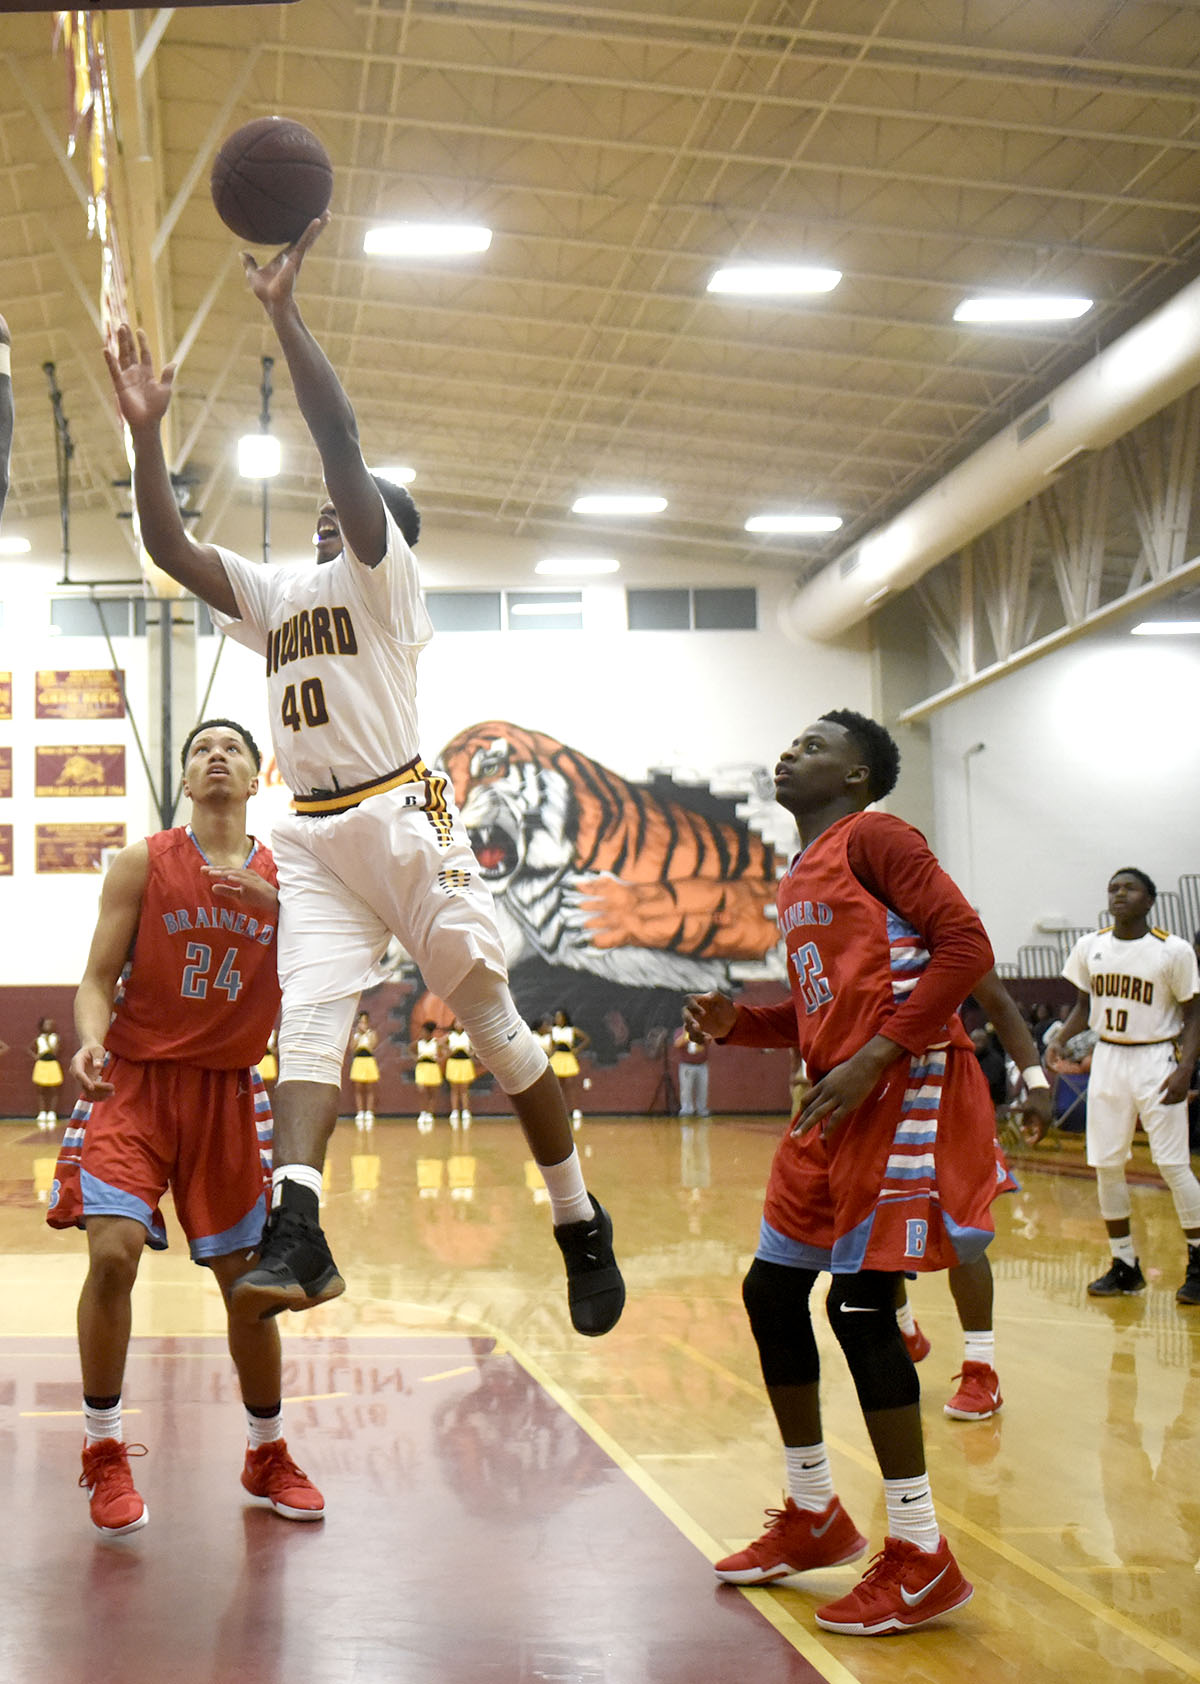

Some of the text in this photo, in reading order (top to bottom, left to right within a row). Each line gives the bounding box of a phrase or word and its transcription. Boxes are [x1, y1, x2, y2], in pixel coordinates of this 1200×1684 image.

[281, 677, 330, 732] 40
[162, 906, 274, 945] BRAINERD
[180, 941, 243, 1002] 24
[1105, 1008, 1128, 1032] 10
[903, 1218, 928, 1258] B
